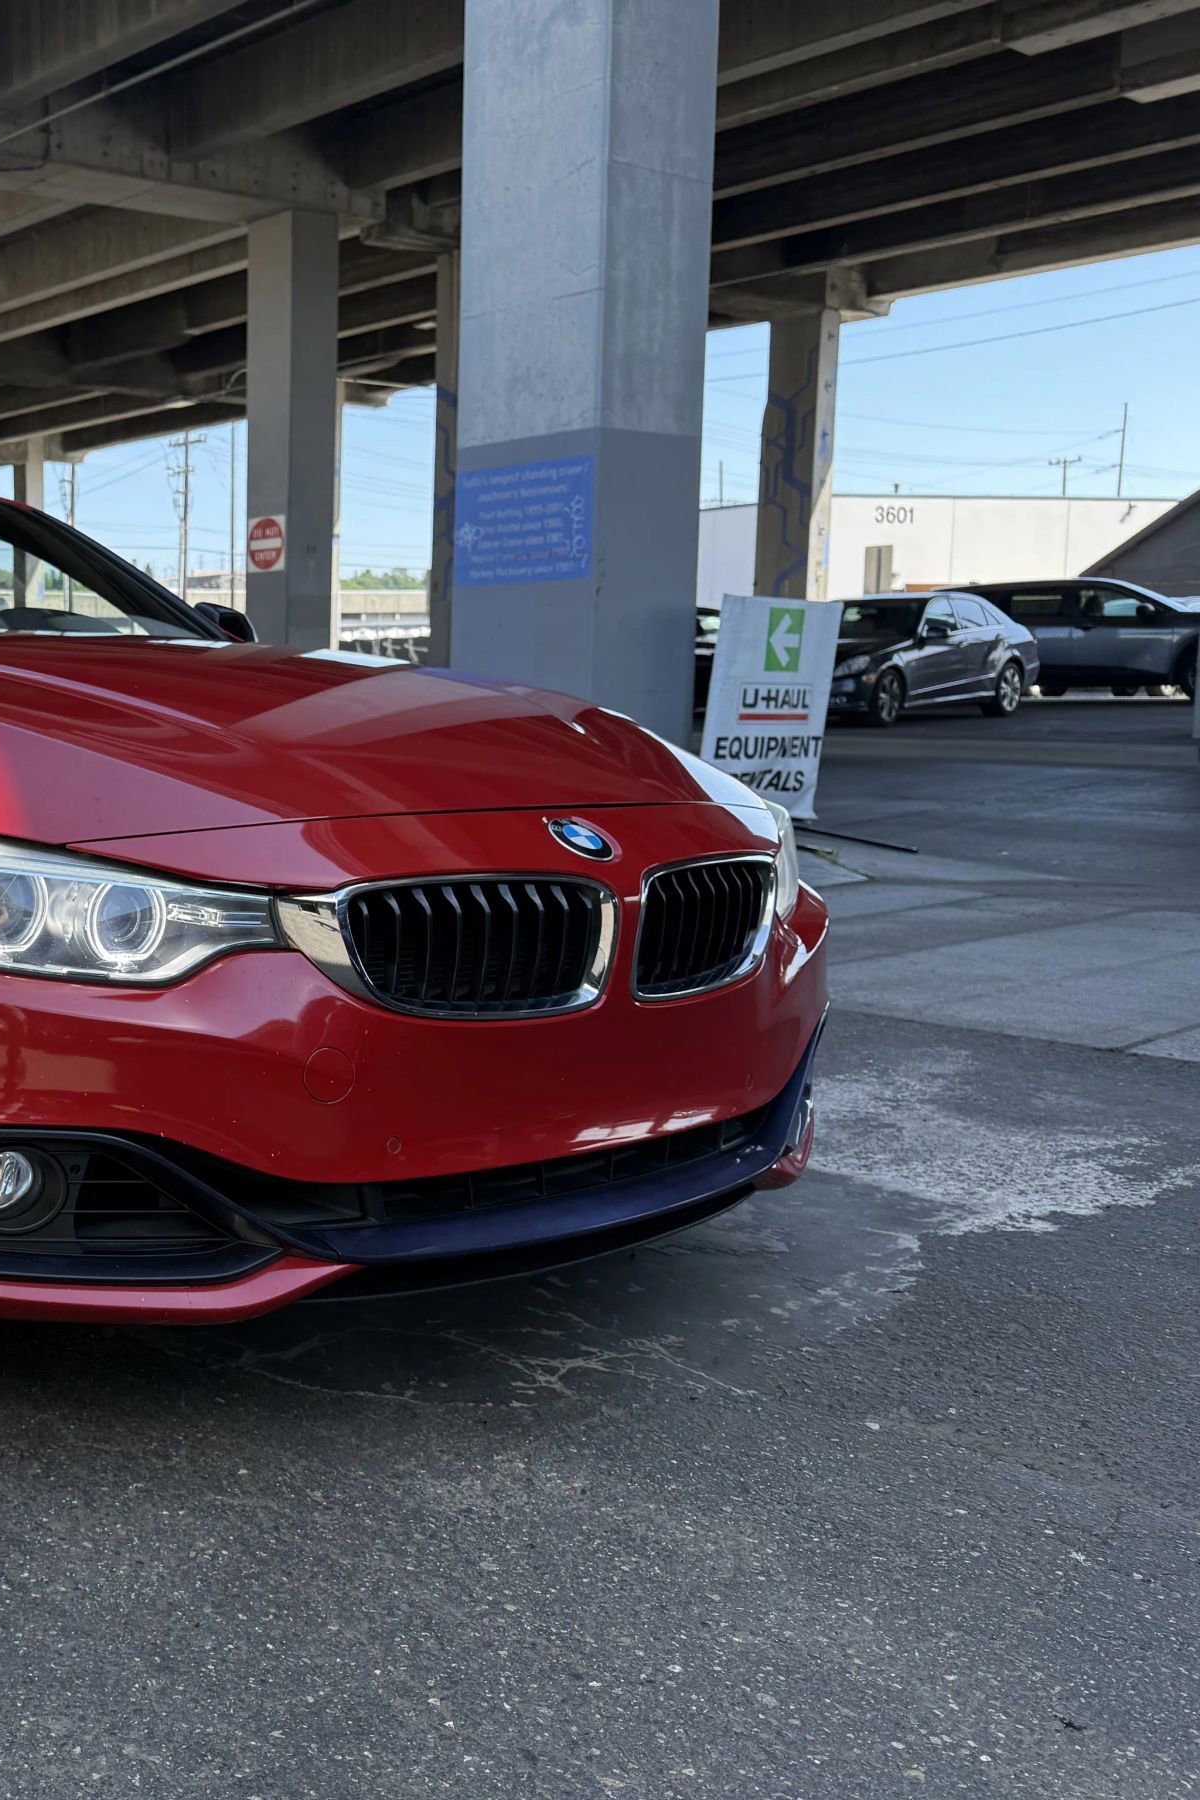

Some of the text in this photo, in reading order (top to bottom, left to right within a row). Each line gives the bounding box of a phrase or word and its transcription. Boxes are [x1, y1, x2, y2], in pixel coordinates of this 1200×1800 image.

[875, 505, 914, 524] 3601
[742, 688, 809, 709] U-HAUL
[714, 736, 821, 760] EQUIPMENT
